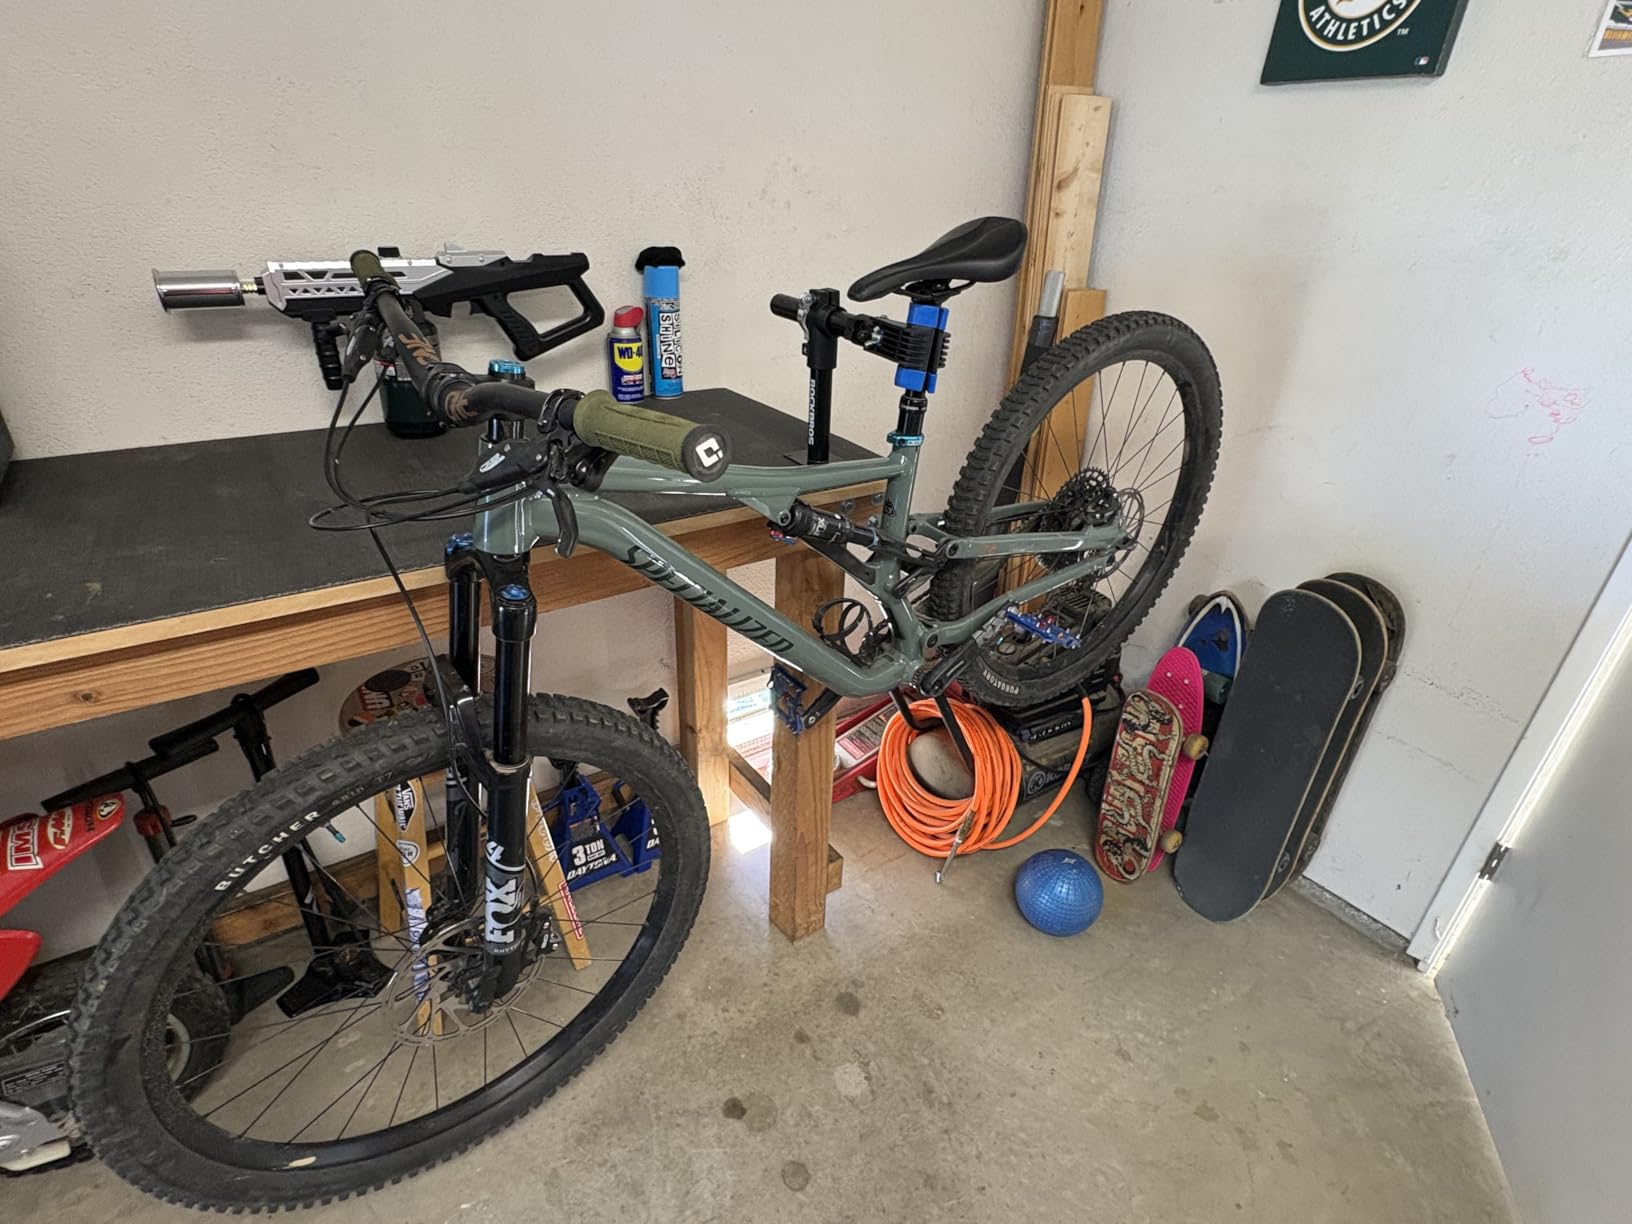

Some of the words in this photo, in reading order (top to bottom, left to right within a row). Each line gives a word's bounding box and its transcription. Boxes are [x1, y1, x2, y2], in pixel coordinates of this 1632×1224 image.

[1309, 0, 1406, 40] ATHLETICS
[617, 345, 643, 359] WD-4
[808, 378, 816, 446] ROCKBROS
[624, 545, 795, 652] SPECIALIZED
[982, 669, 1019, 695] PURGATORY
[402, 787, 415, 811] VANS
[214, 810, 320, 891] BUTCHER
[572, 845, 587, 866] 3
[585, 839, 605, 855] TON
[485, 875, 519, 944] FOX
